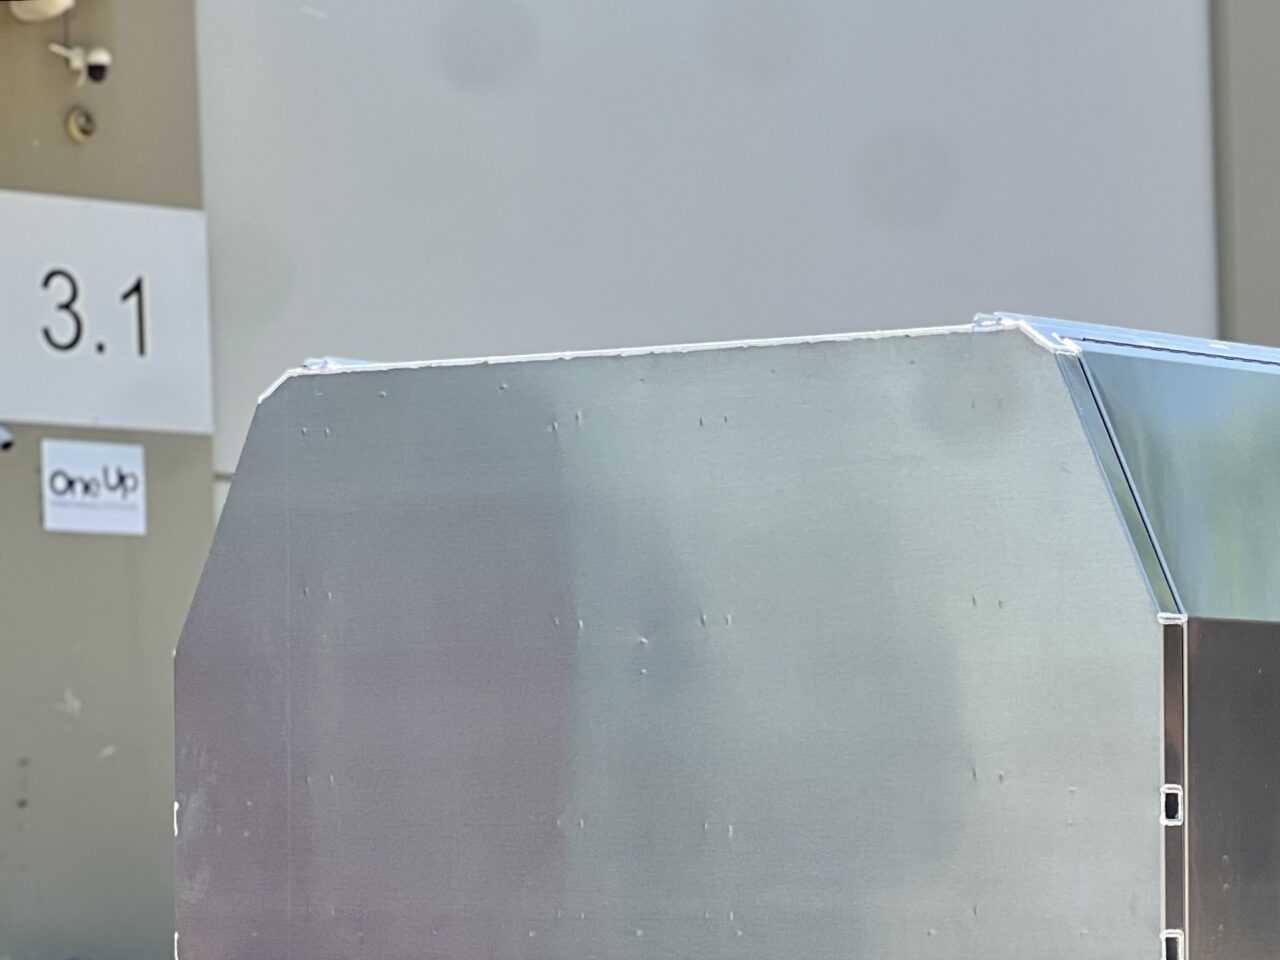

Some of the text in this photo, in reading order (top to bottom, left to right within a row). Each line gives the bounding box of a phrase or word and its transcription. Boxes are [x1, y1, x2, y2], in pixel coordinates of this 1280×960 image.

[42, 269, 146, 357] 3.1
[50, 465, 139, 500] One Up
